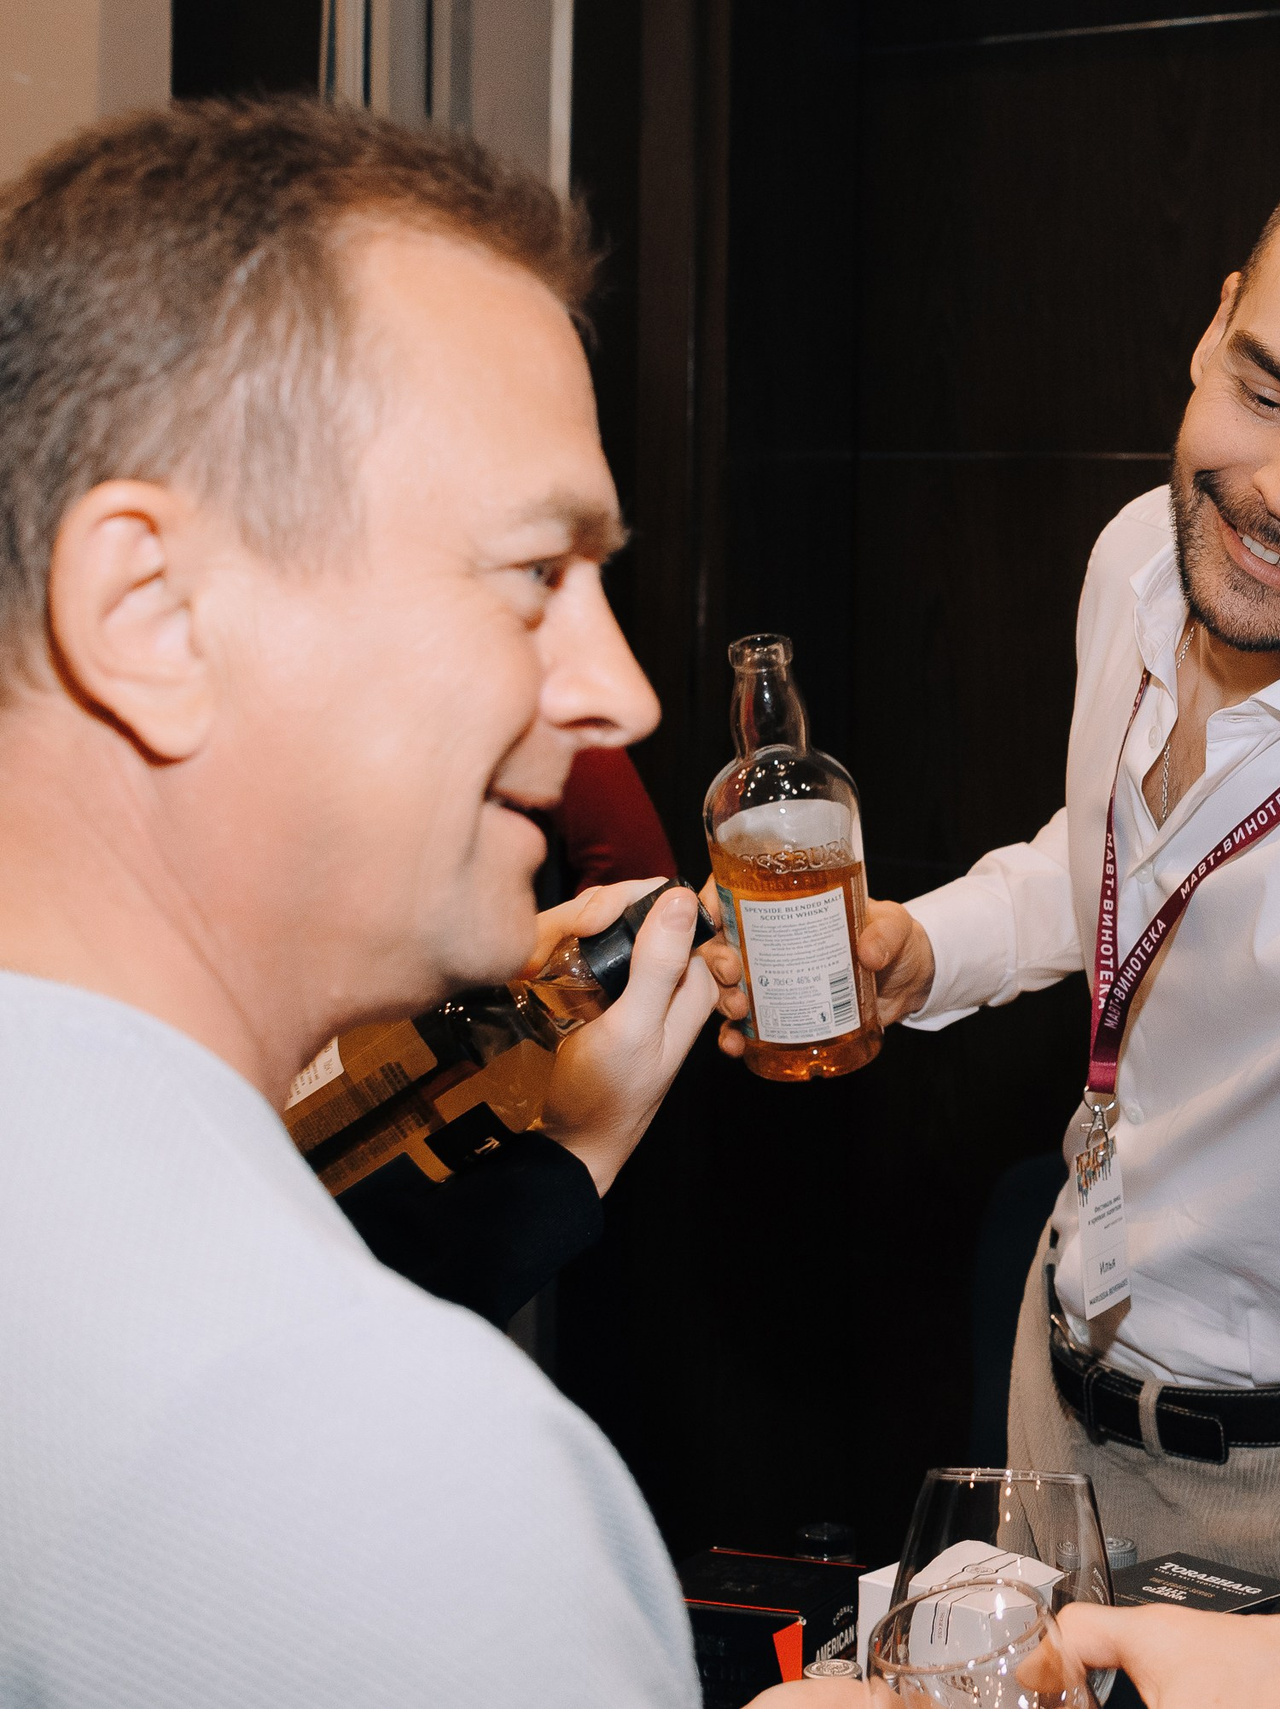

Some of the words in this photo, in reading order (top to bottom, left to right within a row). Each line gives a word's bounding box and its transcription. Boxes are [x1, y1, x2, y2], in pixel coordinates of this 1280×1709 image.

[744, 906, 782, 914] SPEYSIDE
[785, 901, 822, 913] BLENDED
[823, 893, 843, 905] MALT
[760, 913, 793, 921] SCOTCH
[795, 906, 829, 919] WHISKY
[1159, 1562, 1262, 1595] TORABHAIG
[815, 1624, 855, 1662] AMERICAN
